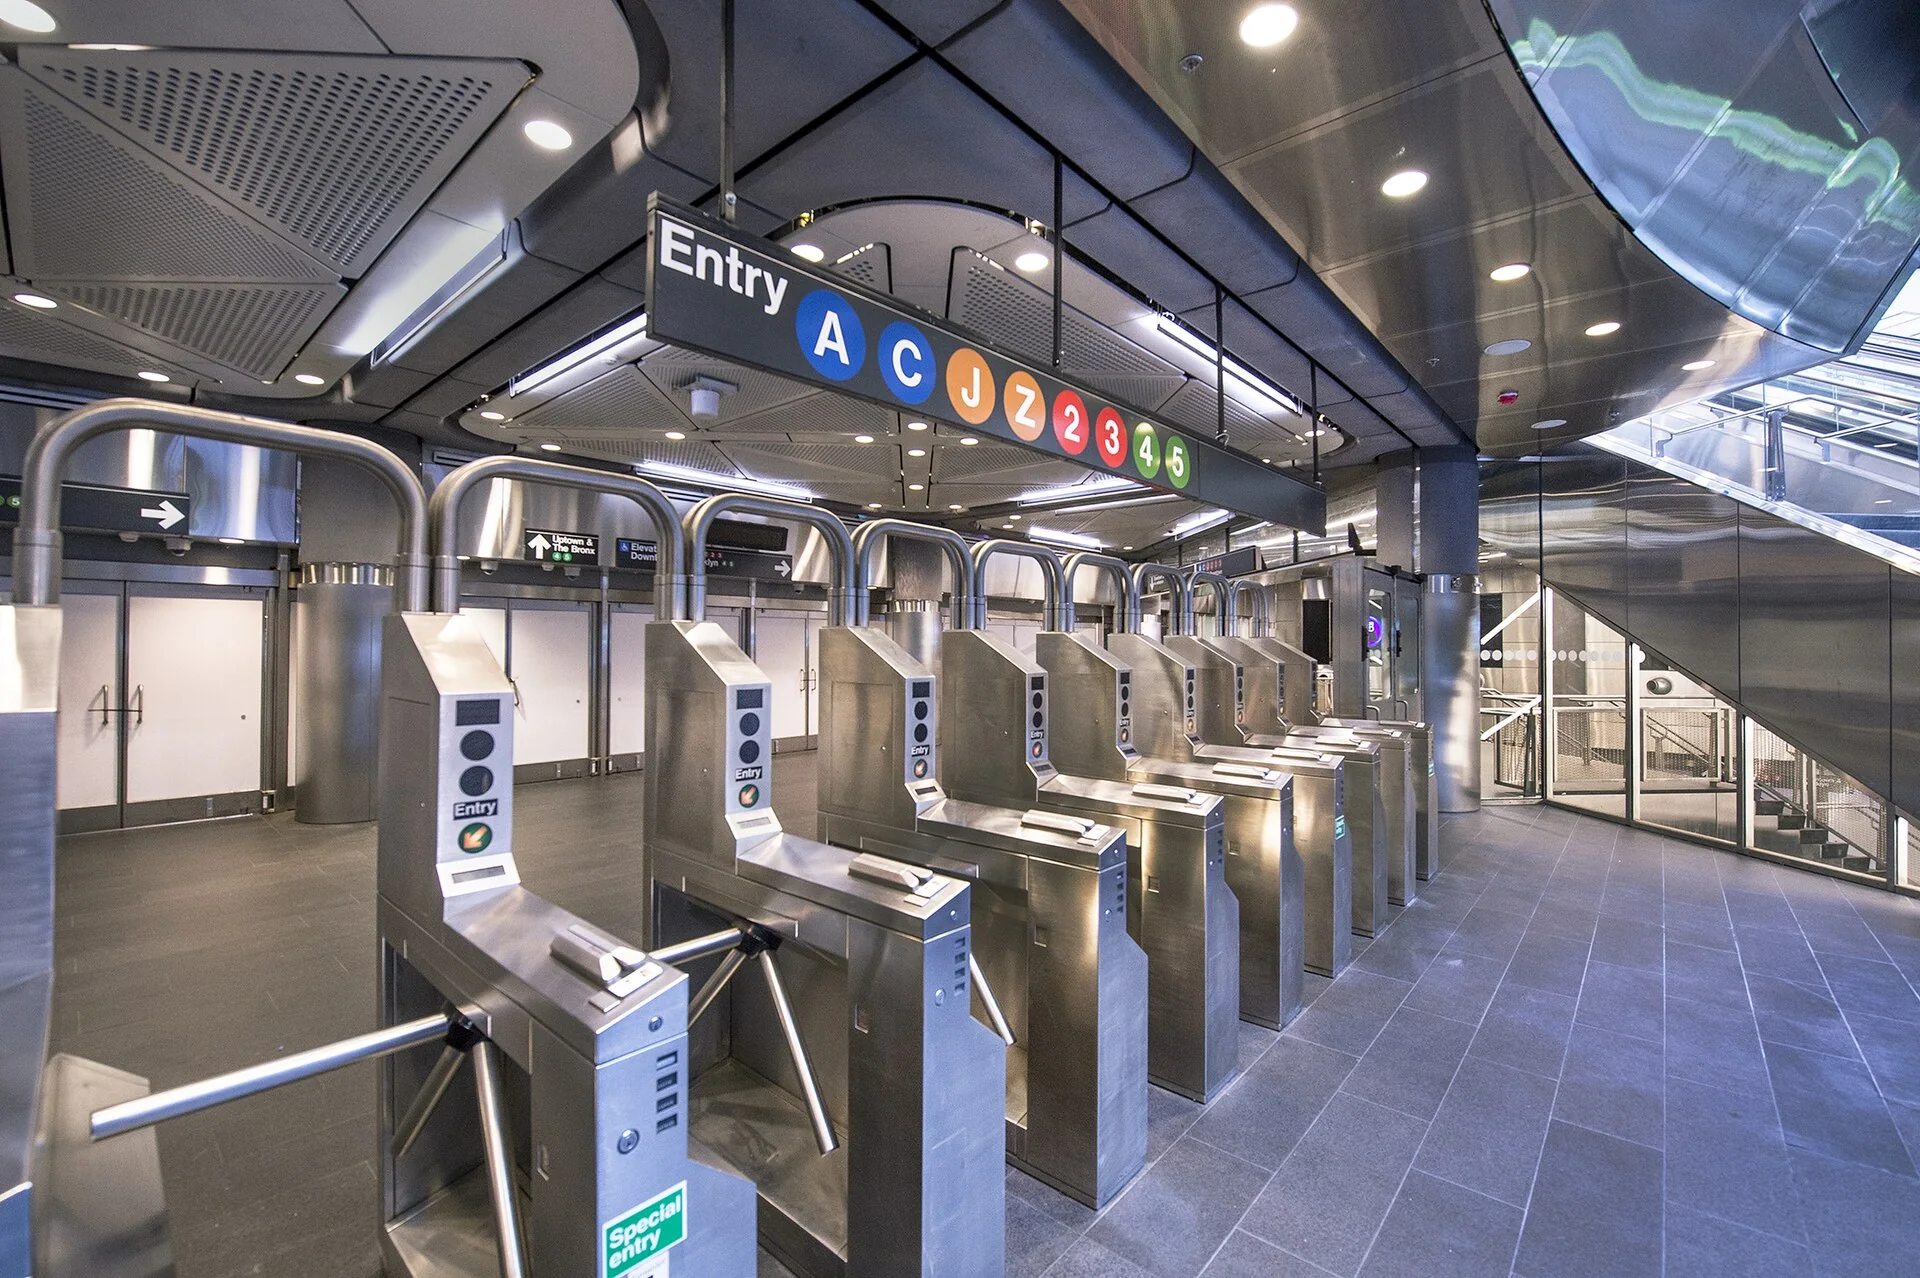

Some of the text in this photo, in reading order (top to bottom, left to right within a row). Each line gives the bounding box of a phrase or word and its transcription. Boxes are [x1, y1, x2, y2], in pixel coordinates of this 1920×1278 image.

[661, 219, 1184, 477] Entry A C J Z 2 3 4 5
[552, 535, 584, 546] Uptown
[552, 543, 595, 555] The Bronx
[911, 745, 929, 755] Entry
[735, 767, 762, 780] Entry
[454, 800, 497, 817] Entry
[609, 1194, 681, 1249] Special
[609, 1228, 661, 1269] entry
